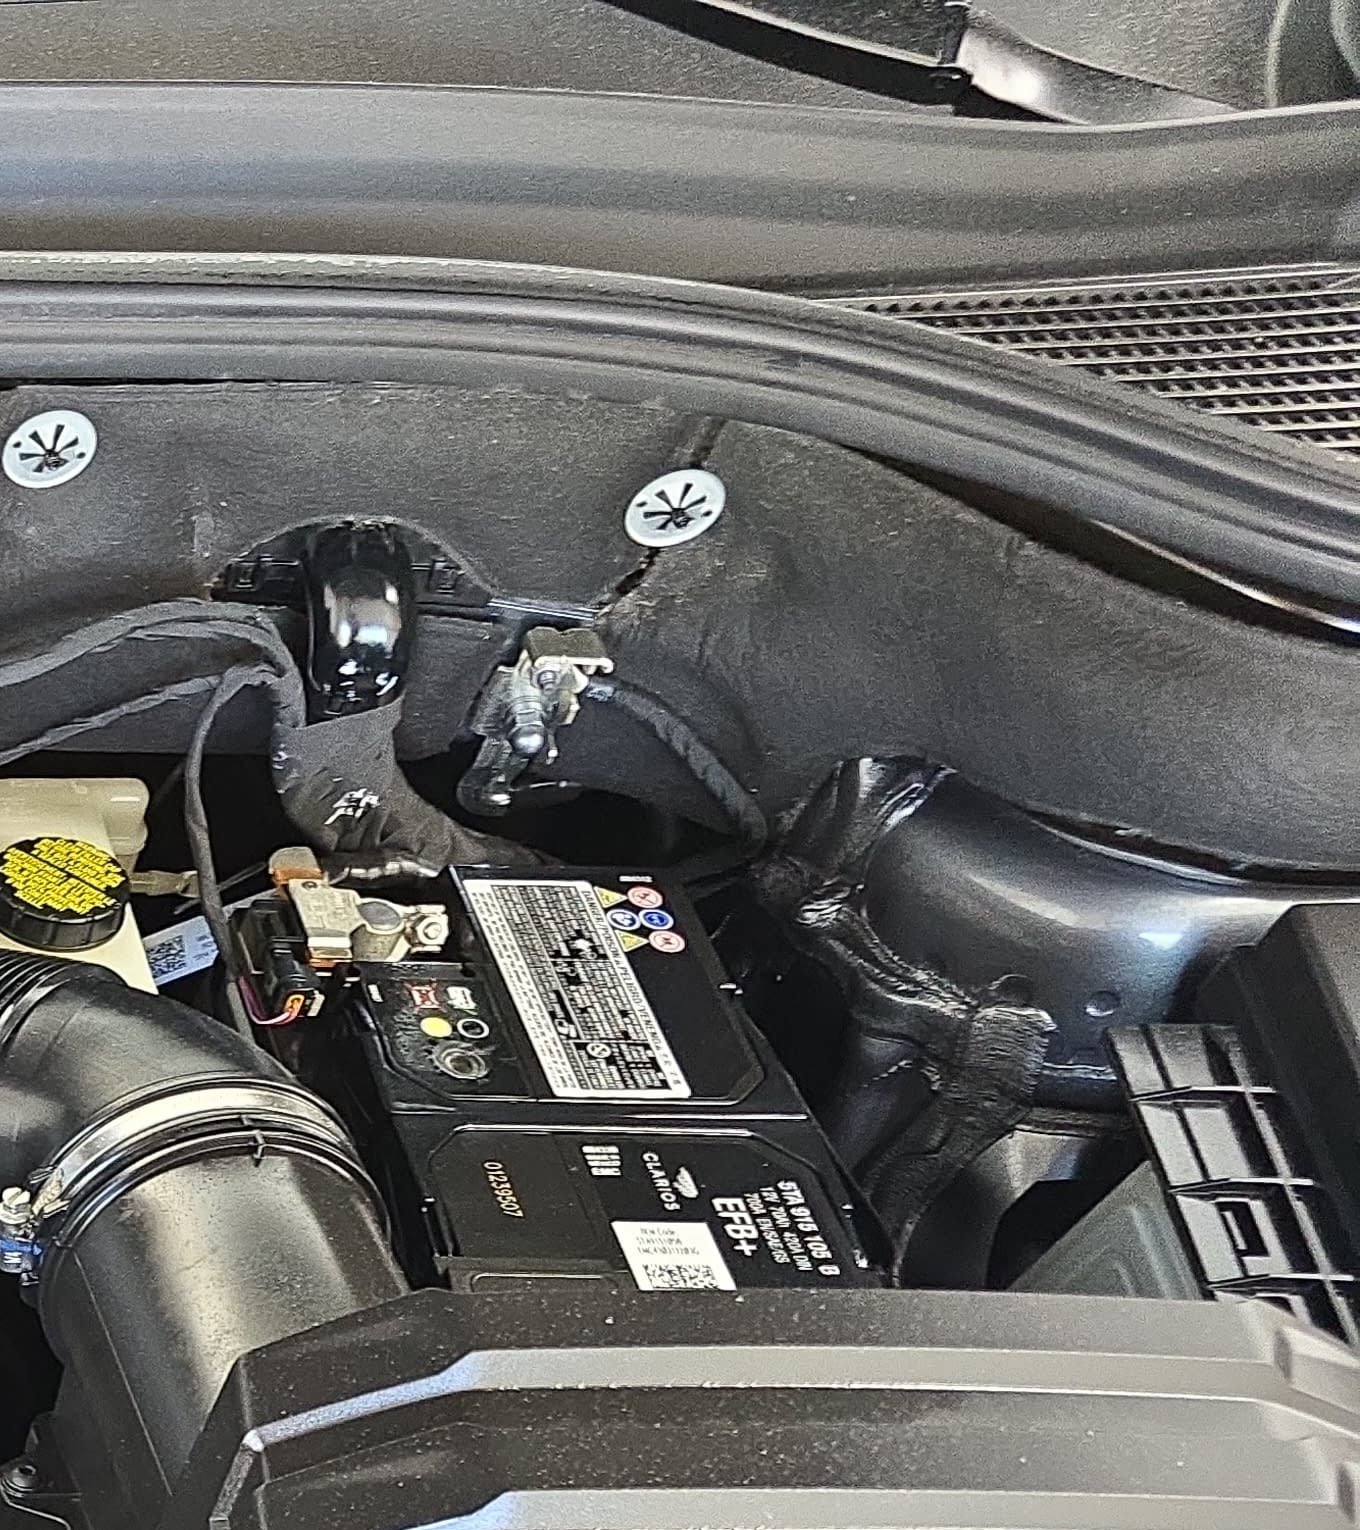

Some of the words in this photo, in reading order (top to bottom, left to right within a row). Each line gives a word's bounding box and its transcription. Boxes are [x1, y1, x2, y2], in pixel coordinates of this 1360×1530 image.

[483, 1161, 525, 1219] 01239507
[643, 1151, 681, 1212] CLARIOS
[712, 1197, 759, 1257] EFB+
[790, 1206, 819, 1232] 915
[793, 1255, 814, 1271] DIN
[804, 1235, 832, 1259] 105
